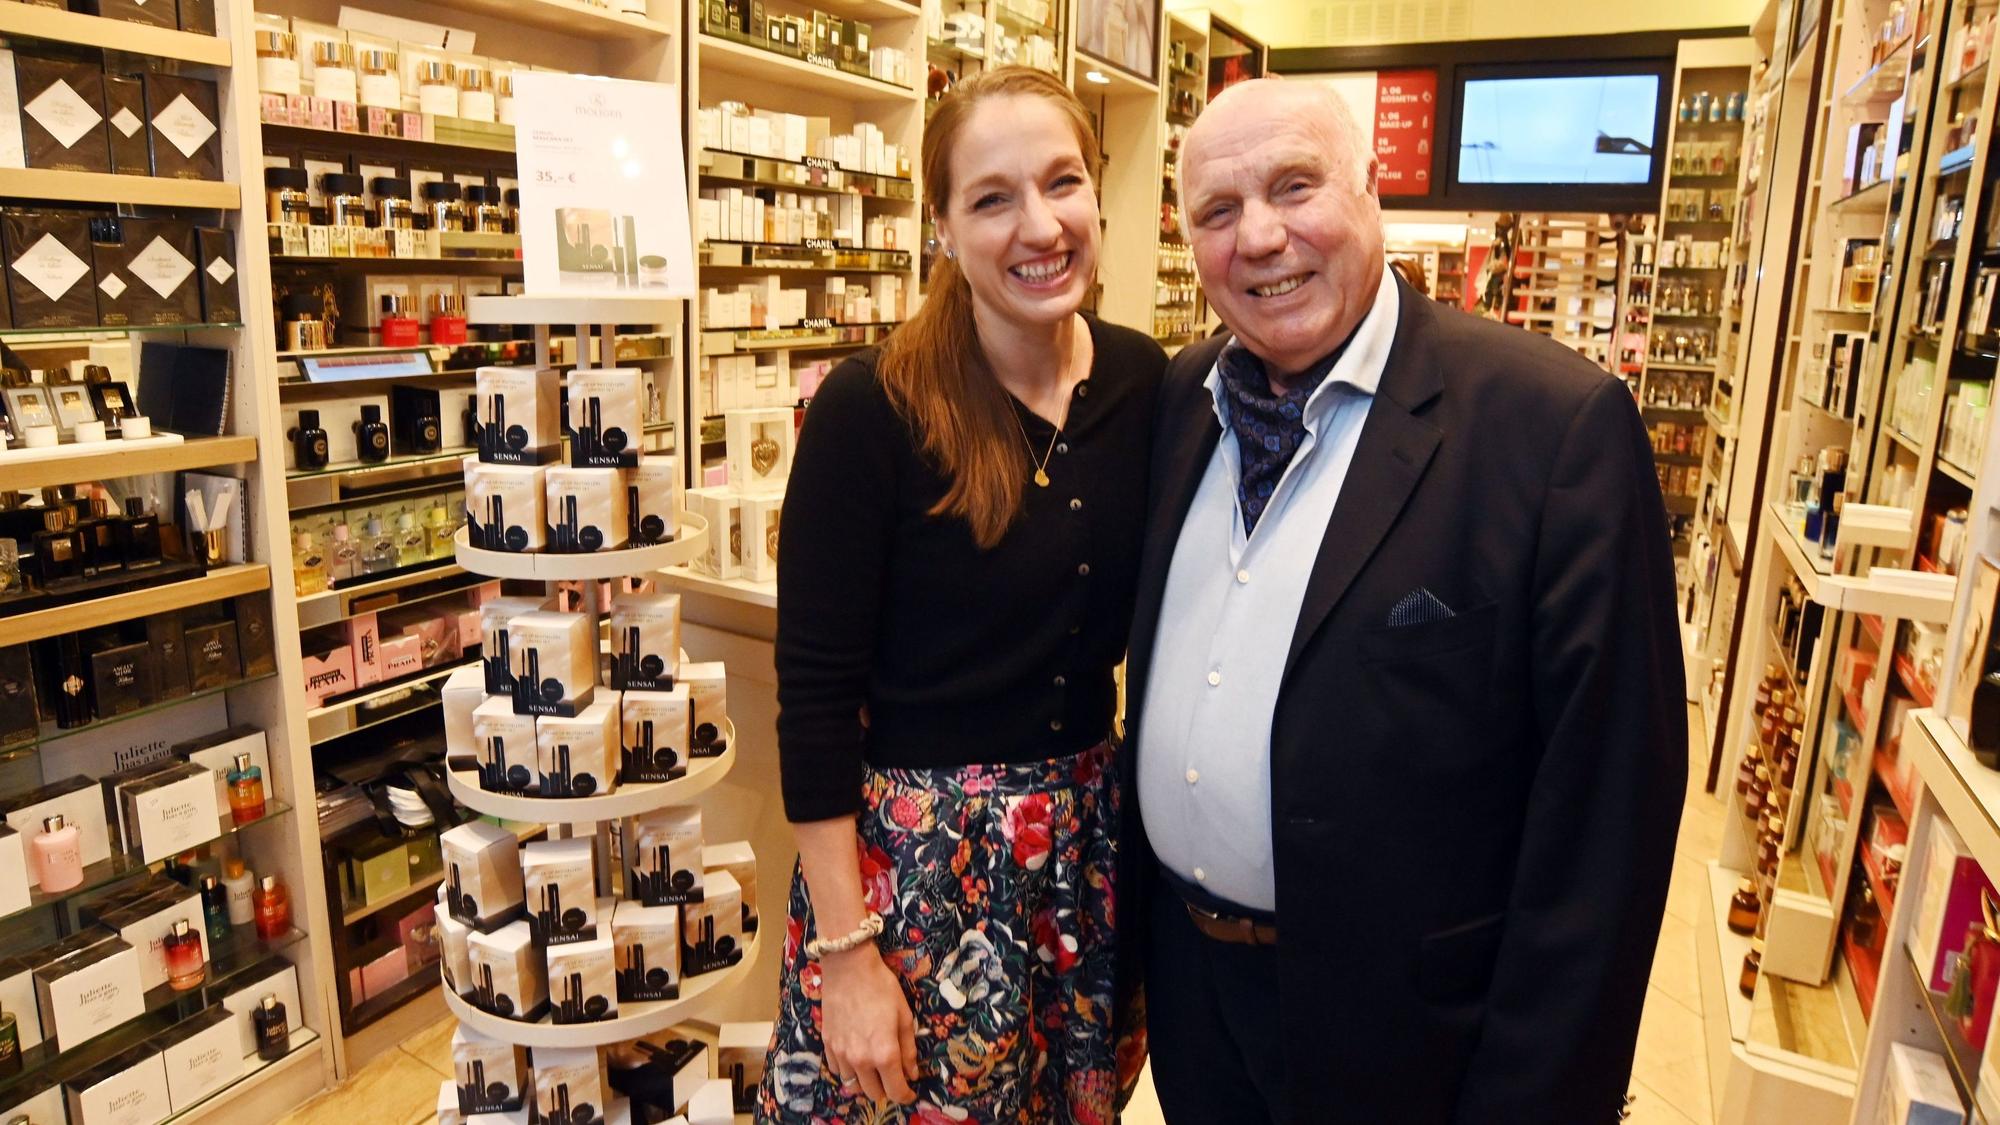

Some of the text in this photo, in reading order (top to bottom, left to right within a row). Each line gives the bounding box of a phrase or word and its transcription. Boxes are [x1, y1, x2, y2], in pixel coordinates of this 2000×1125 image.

[807, 52, 837, 70] CHANEL
[1379, 120, 1413, 129] MAKE-UP
[1377, 145, 1397, 154] DUFT
[806, 156, 836, 171] CHANEL
[806, 238, 835, 250] CHANEL
[803, 318, 832, 329] CHANEL
[493, 452, 521, 462] SENSAI
[588, 456, 620, 464] SENSAI
[627, 680, 656, 688] SENSAI
[528, 704, 557, 713] SENSAI
[113, 739, 167, 774] Juliette
[640, 772, 669, 780] SENSAI
[162, 802, 192, 822] Juliette
[659, 894, 687, 903] SENSAI
[548, 932, 580, 943] SENSAI
[702, 959, 728, 970] SENSAI
[80, 982, 113, 1007] Juliette
[633, 990, 662, 999] SENSAI
[108, 1089, 139, 1114] Juliette
[475, 1104, 503, 1113] SENSAI
